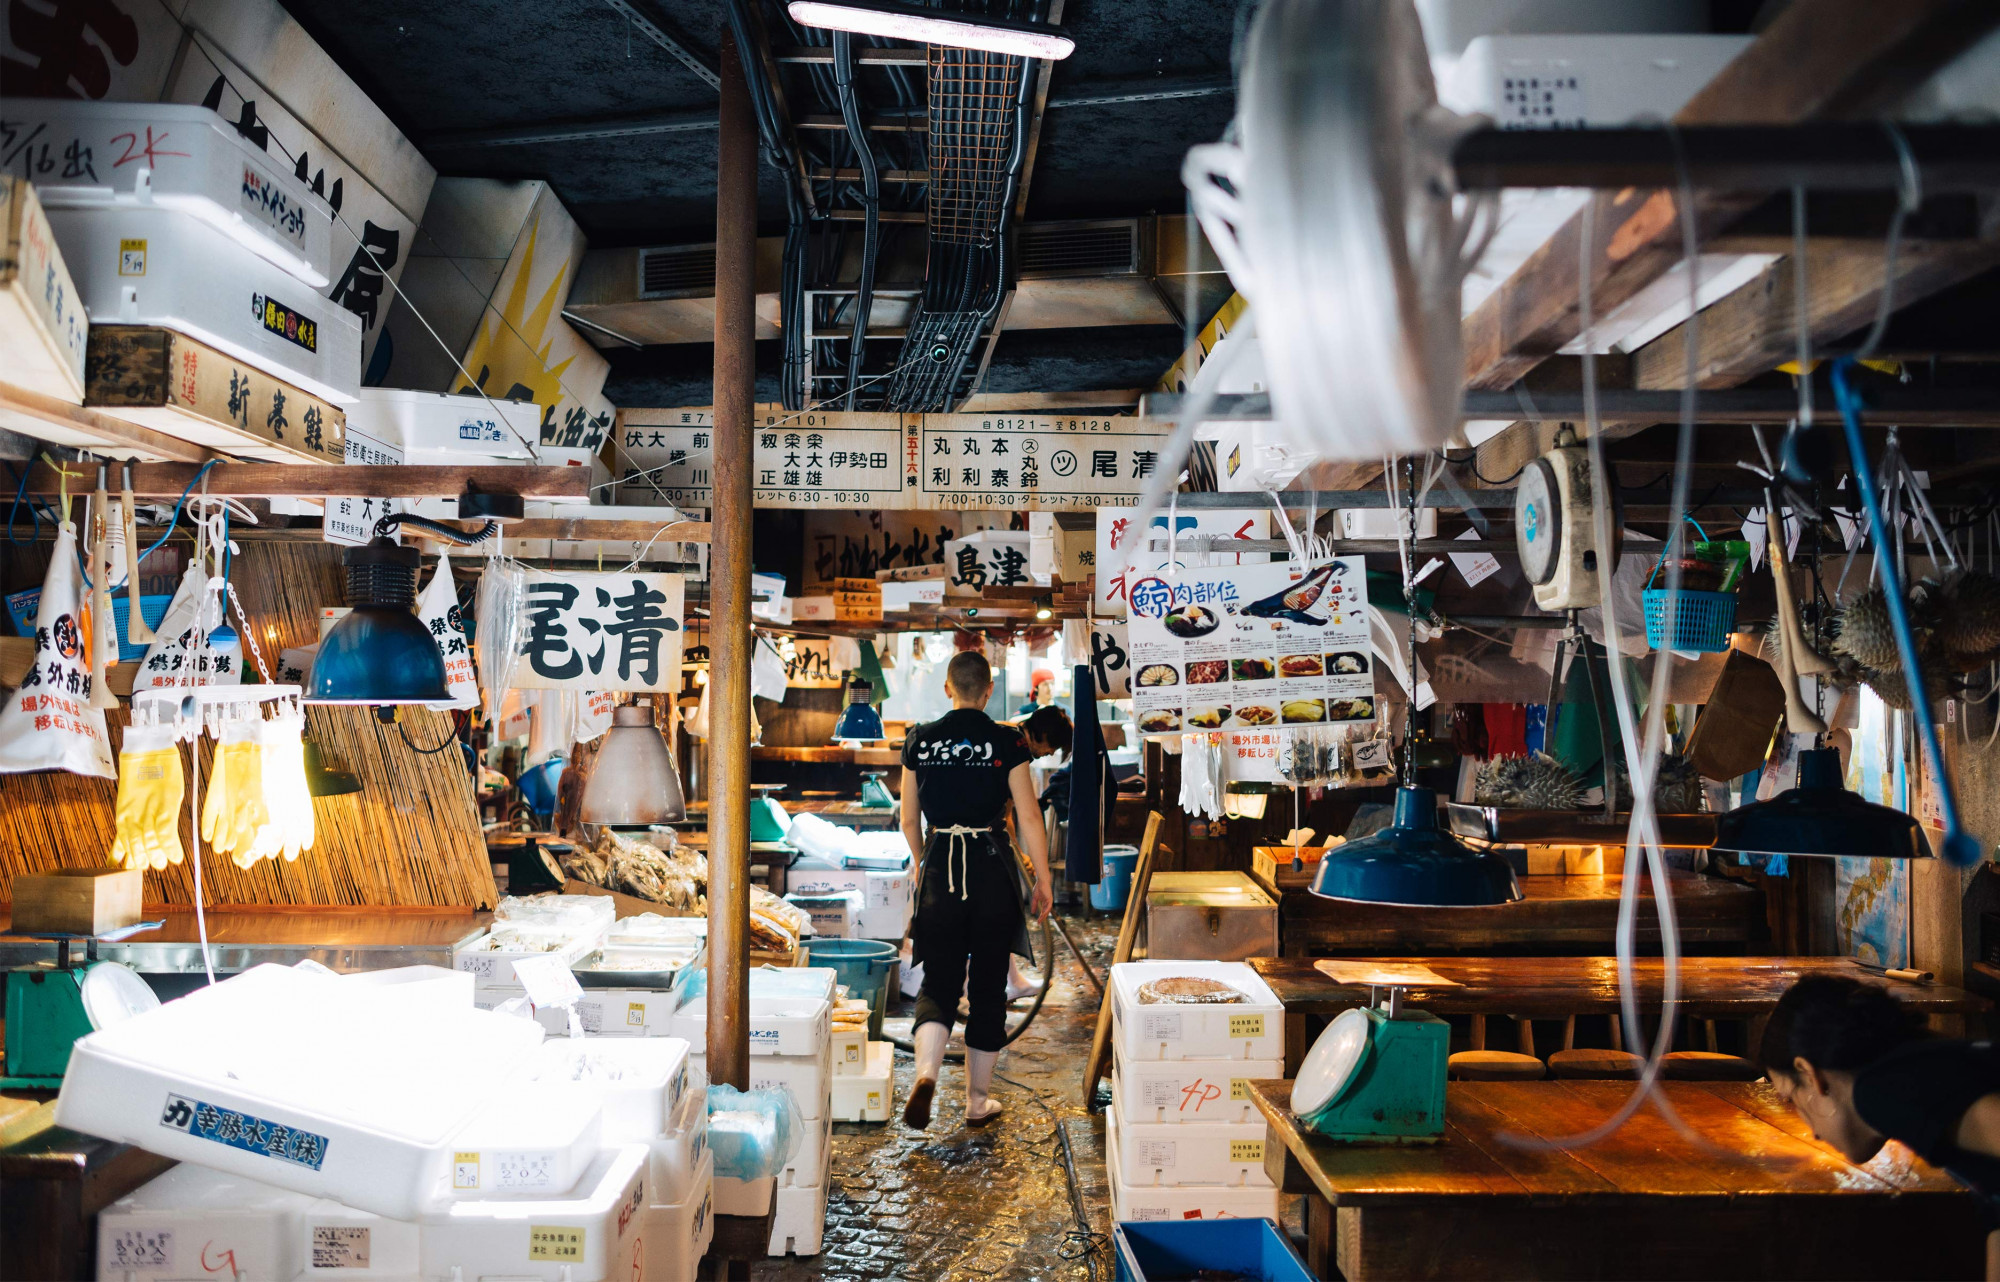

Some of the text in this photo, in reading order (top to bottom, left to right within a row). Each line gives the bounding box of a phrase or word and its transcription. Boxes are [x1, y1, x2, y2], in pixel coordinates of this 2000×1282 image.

[681, 412, 713, 424] 至7
[828, 451, 888, 469] 伊勢田
[906, 425, 919, 487] 第五十六棟
[753, 491, 786, 500] レット
[950, 543, 1028, 593] 島津
[1131, 577, 1240, 621] 鯨肉部位
[519, 579, 680, 687] 尾清
[917, 738, 993, 761] こだわり
[1231, 734, 1282, 746] 場外市場は
[1180, 1078, 1222, 1112] 4P
[532, 1233, 582, 1243] 中央魚類(株)
[532, 1245, 547, 1254] 本社
